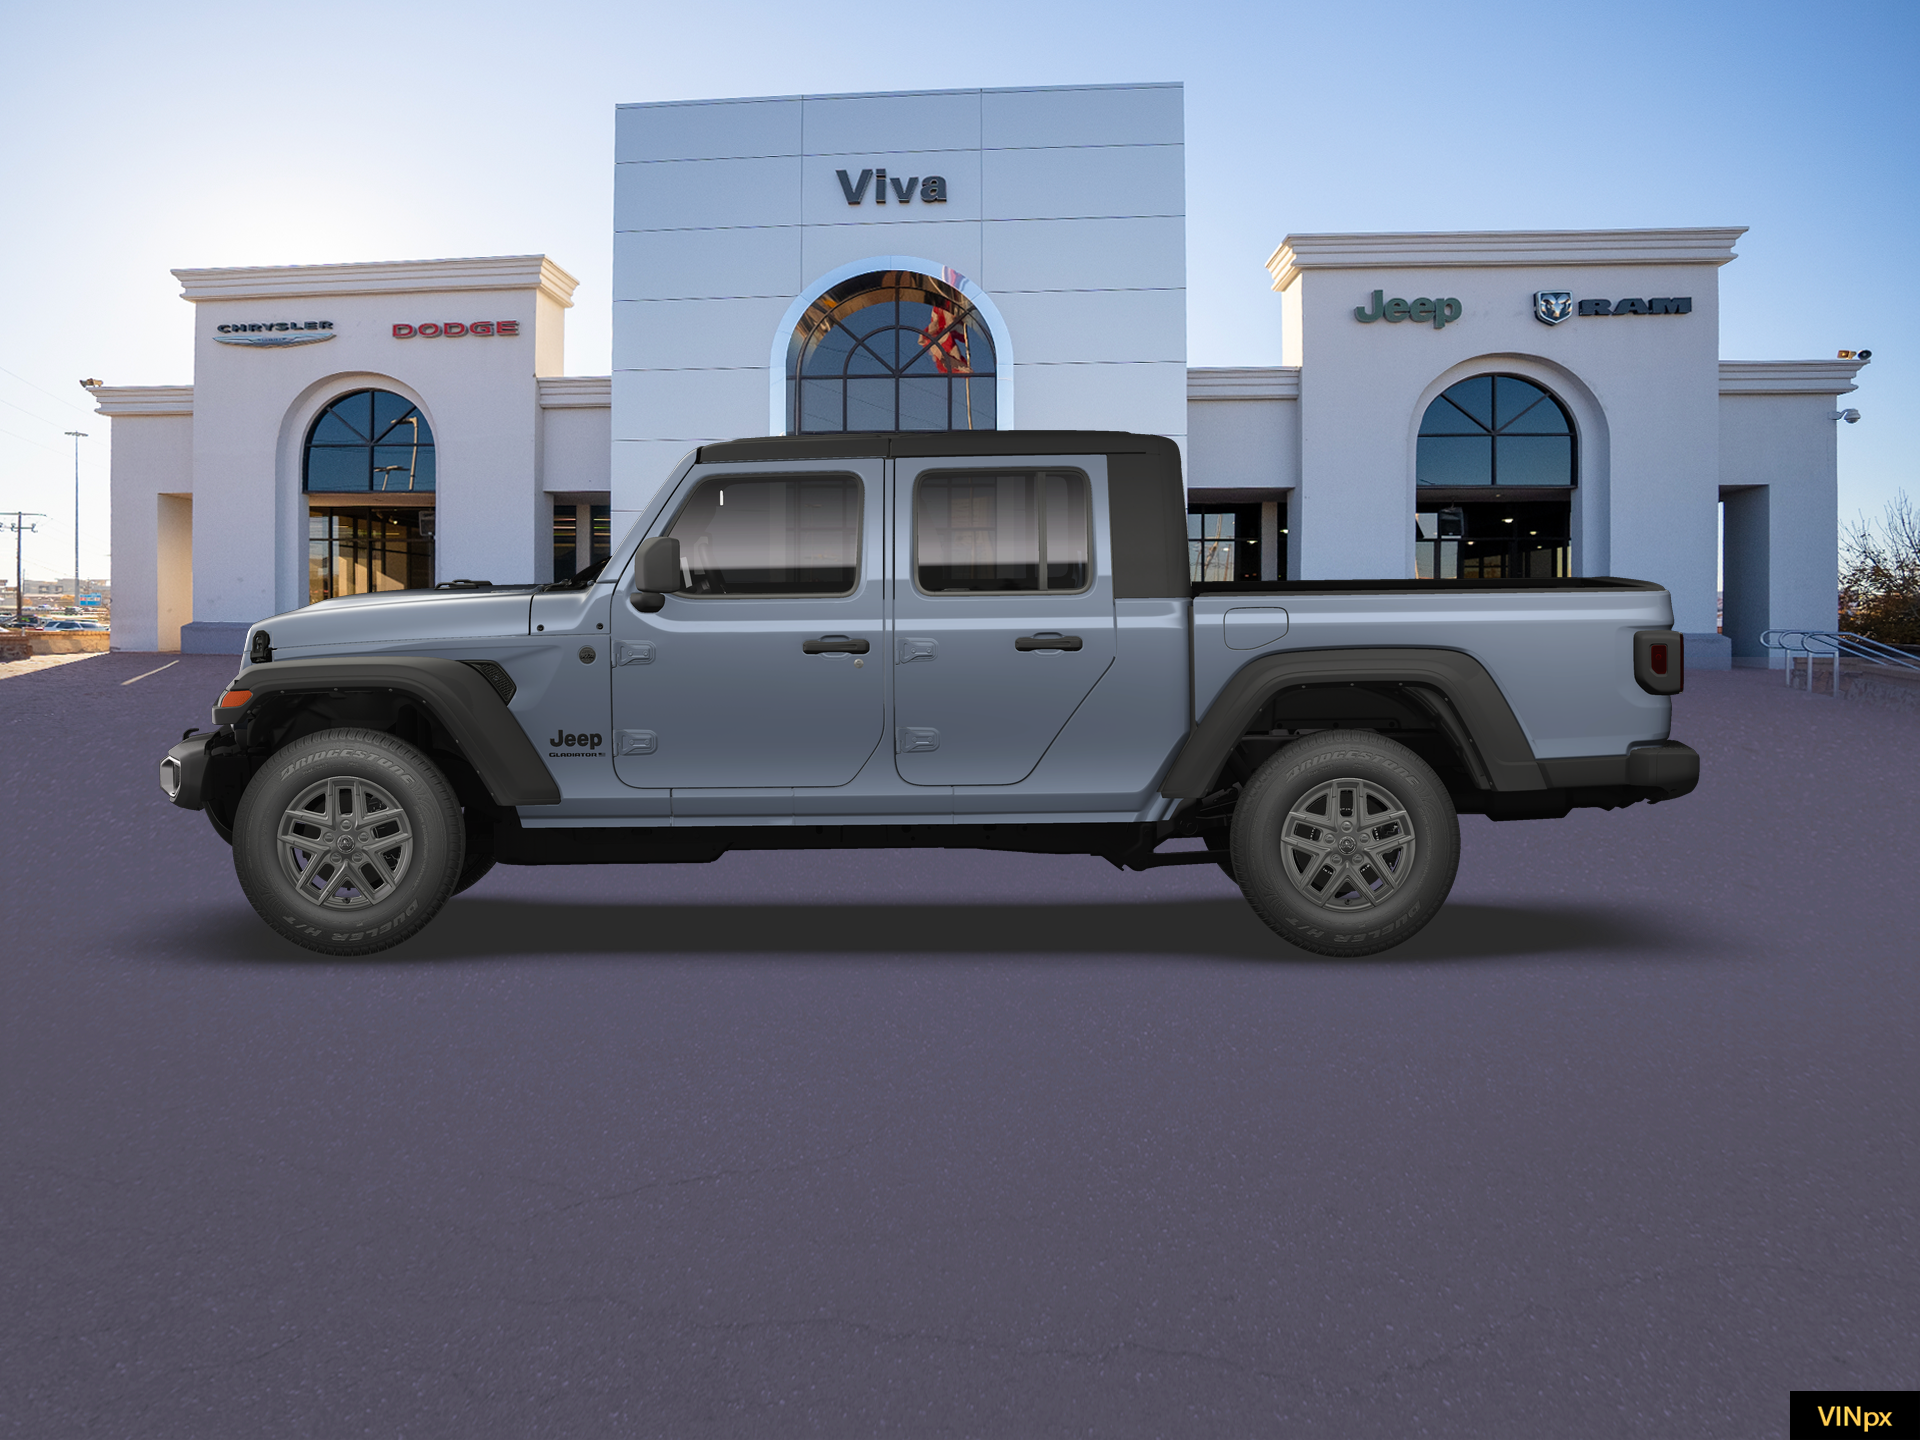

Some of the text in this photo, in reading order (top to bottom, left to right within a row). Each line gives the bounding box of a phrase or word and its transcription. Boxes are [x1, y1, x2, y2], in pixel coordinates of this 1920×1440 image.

[835, 168, 947, 206] Viva
[1354, 289, 1462, 330] Jeep
[1578, 297, 1692, 316] RAM
[217, 320, 334, 333] CHRYSLER
[392, 319, 519, 339] DODGE
[550, 729, 603, 750] Jeep
[280, 749, 417, 784] BRIDGESTONE
[1285, 750, 1421, 786] BRIDGESTONE
[331, 899, 419, 941] DUELER
[1333, 900, 1422, 943] DUELER
